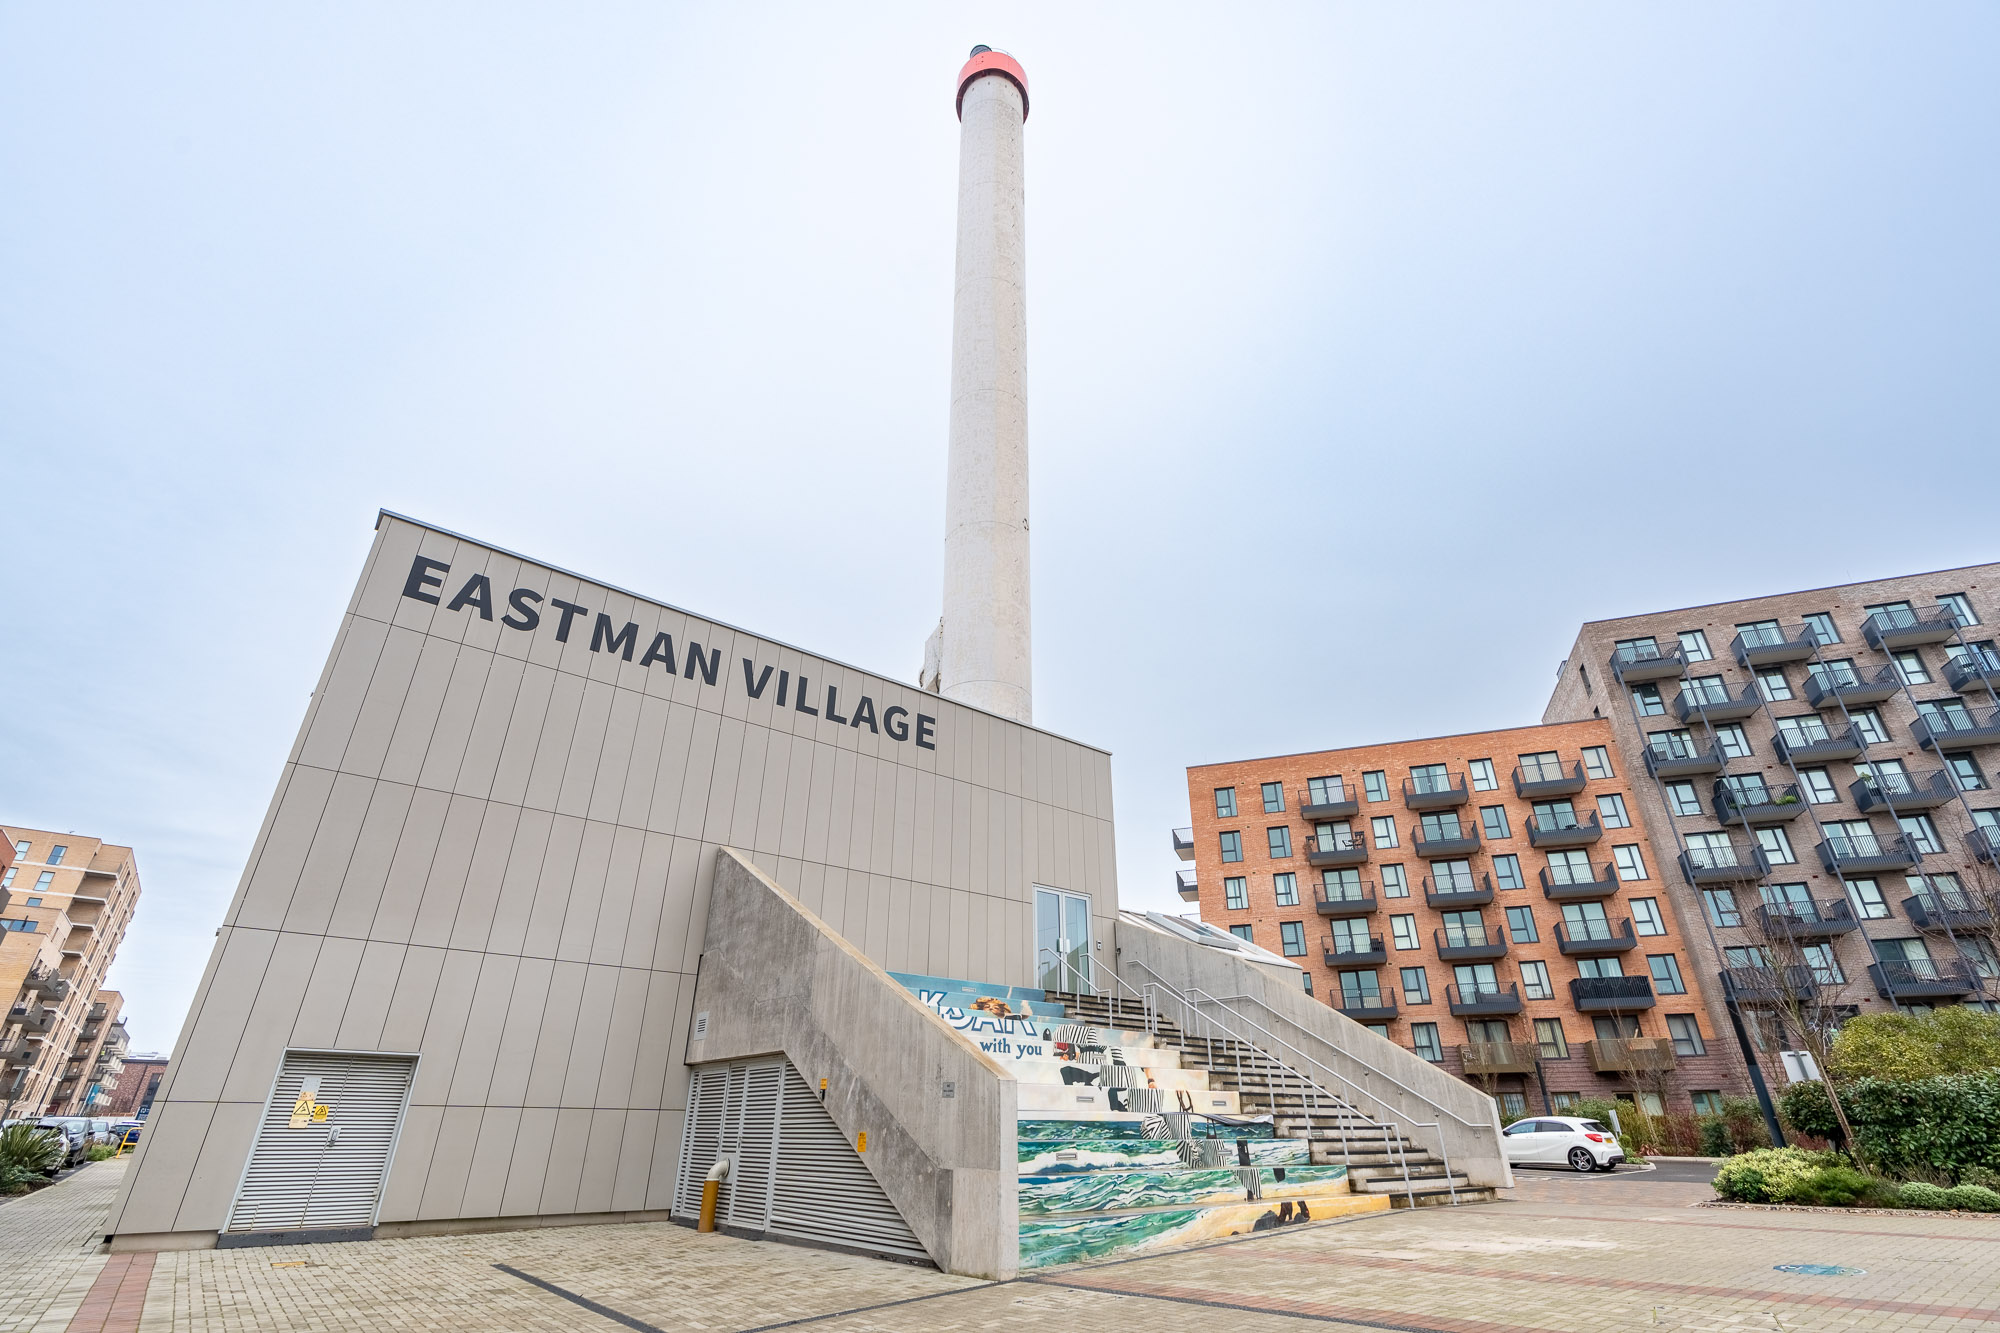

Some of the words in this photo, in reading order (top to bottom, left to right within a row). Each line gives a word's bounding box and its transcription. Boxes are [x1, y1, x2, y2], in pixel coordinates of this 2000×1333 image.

[403, 555, 721, 687] EASTMAN
[742, 657, 936, 751] VILLAGE
[980, 1038, 1011, 1054] with
[1016, 1044, 1043, 1060] you
